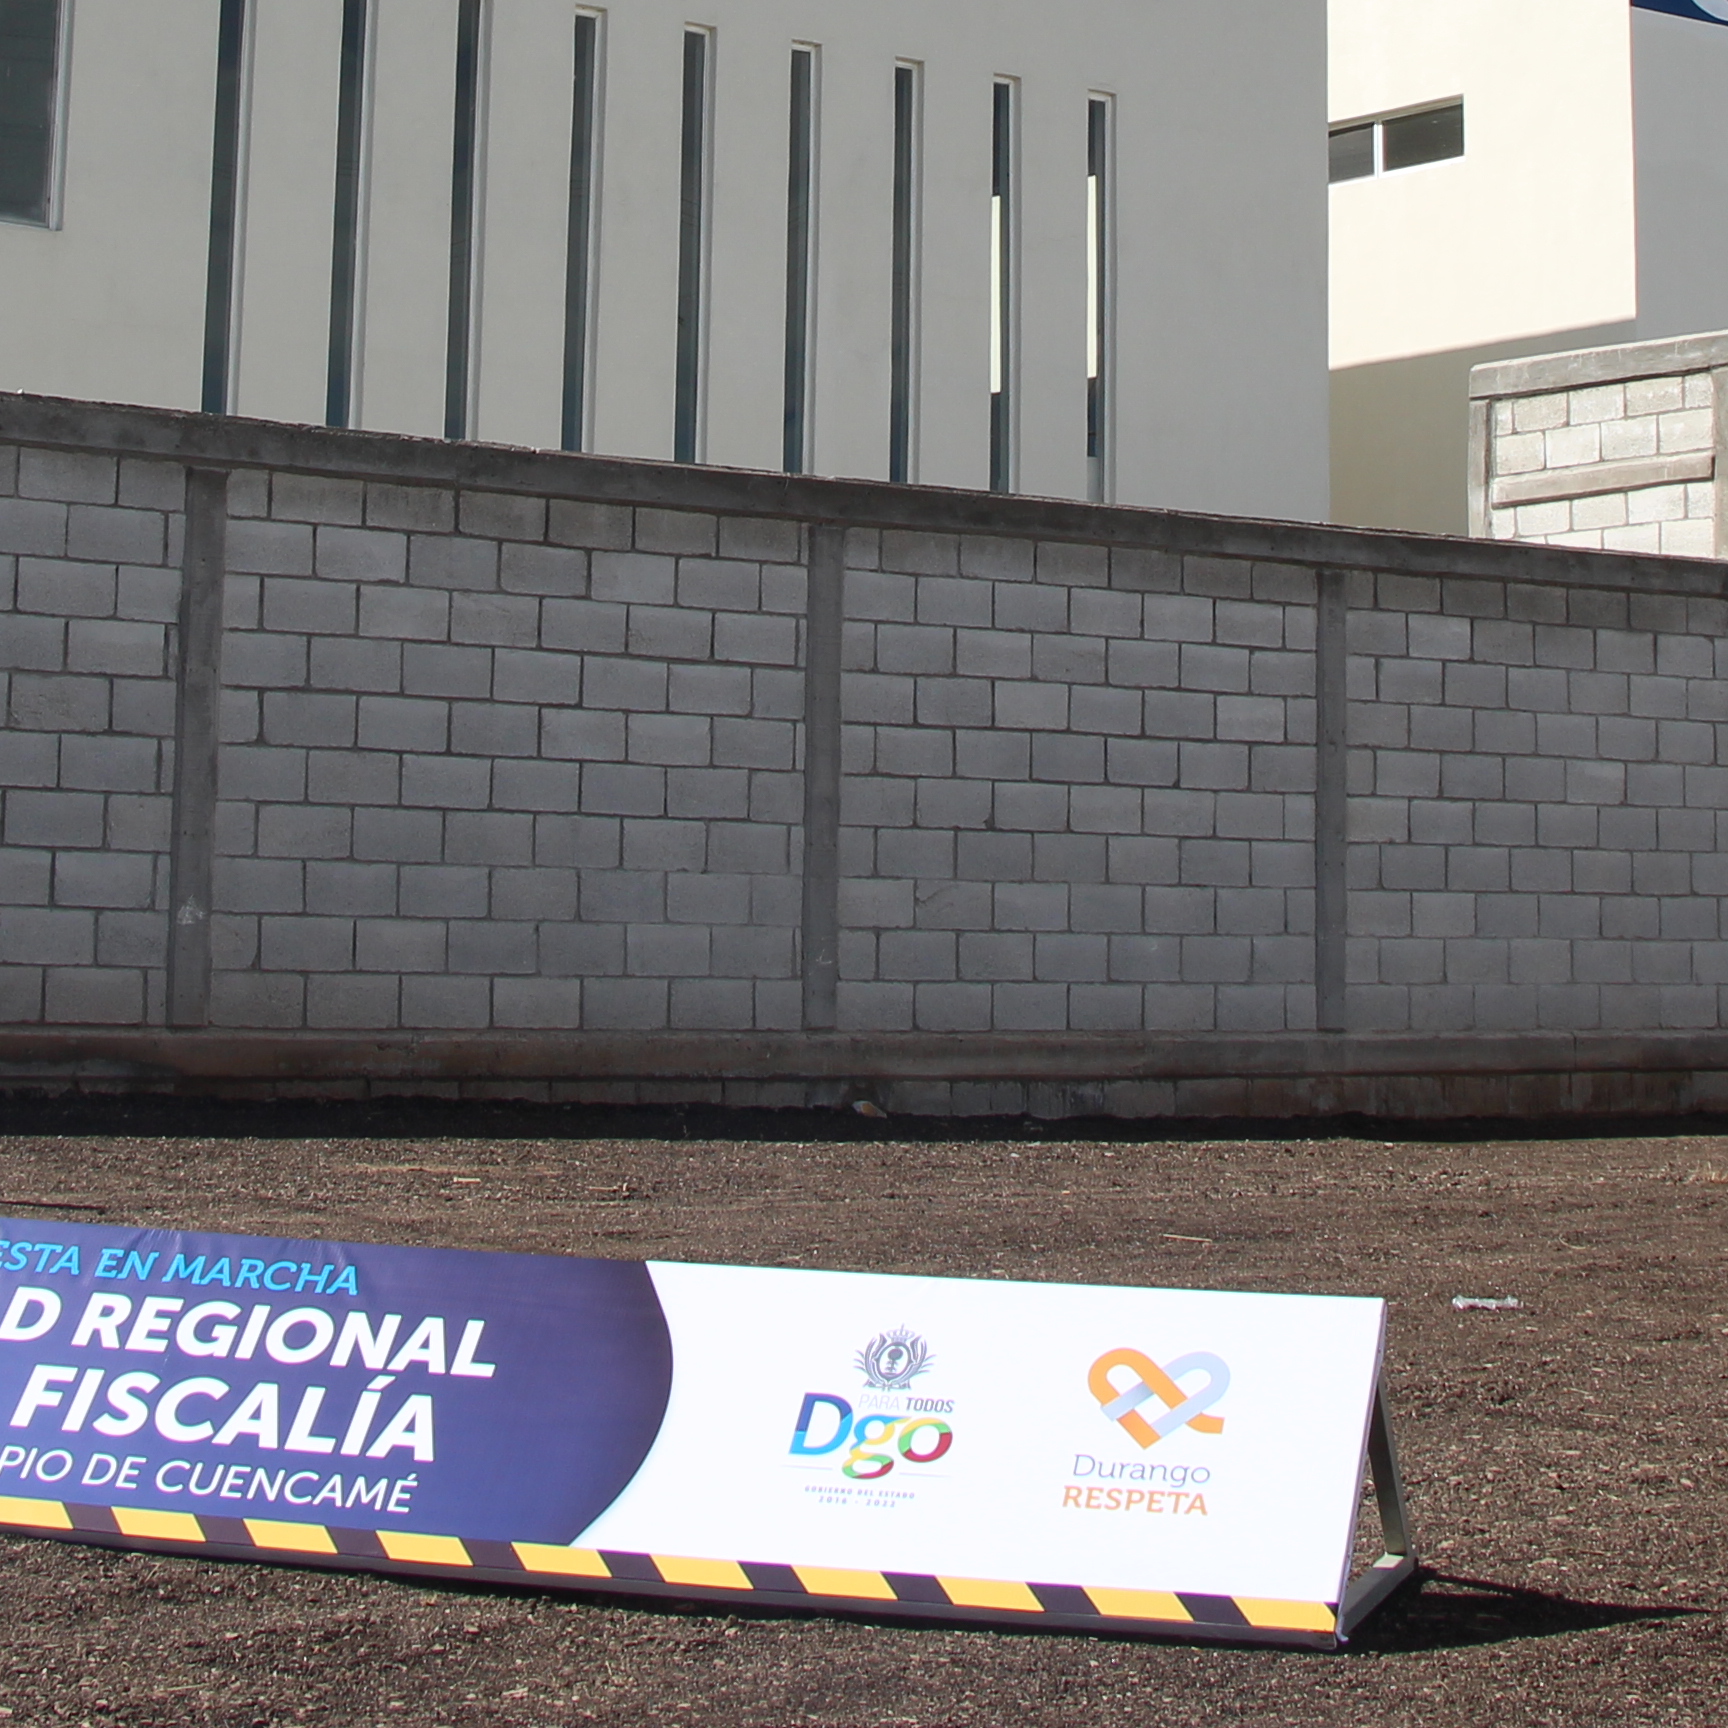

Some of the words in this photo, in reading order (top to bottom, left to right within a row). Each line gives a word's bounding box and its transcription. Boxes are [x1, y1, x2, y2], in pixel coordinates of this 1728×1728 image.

[94, 1247, 160, 1281] EN
[162, 1253, 359, 1296] MARCHA
[71, 1291, 496, 1378] REGIONAL
[9, 1364, 435, 1462] FISCALÍA
[858, 1393, 900, 1411] PARA
[904, 1396, 955, 1414] TODOS
[788, 1392, 954, 1480] Dgo
[81, 1453, 148, 1490] DE
[155, 1460, 419, 1514] CUENCAMÉ
[804, 1485, 853, 1496] GOBIERNO
[857, 1488, 874, 1497] DEL
[878, 1490, 915, 1500] ESTADO
[1071, 1453, 1211, 1488] Durango
[1061, 1484, 1209, 1517] RESPETA
